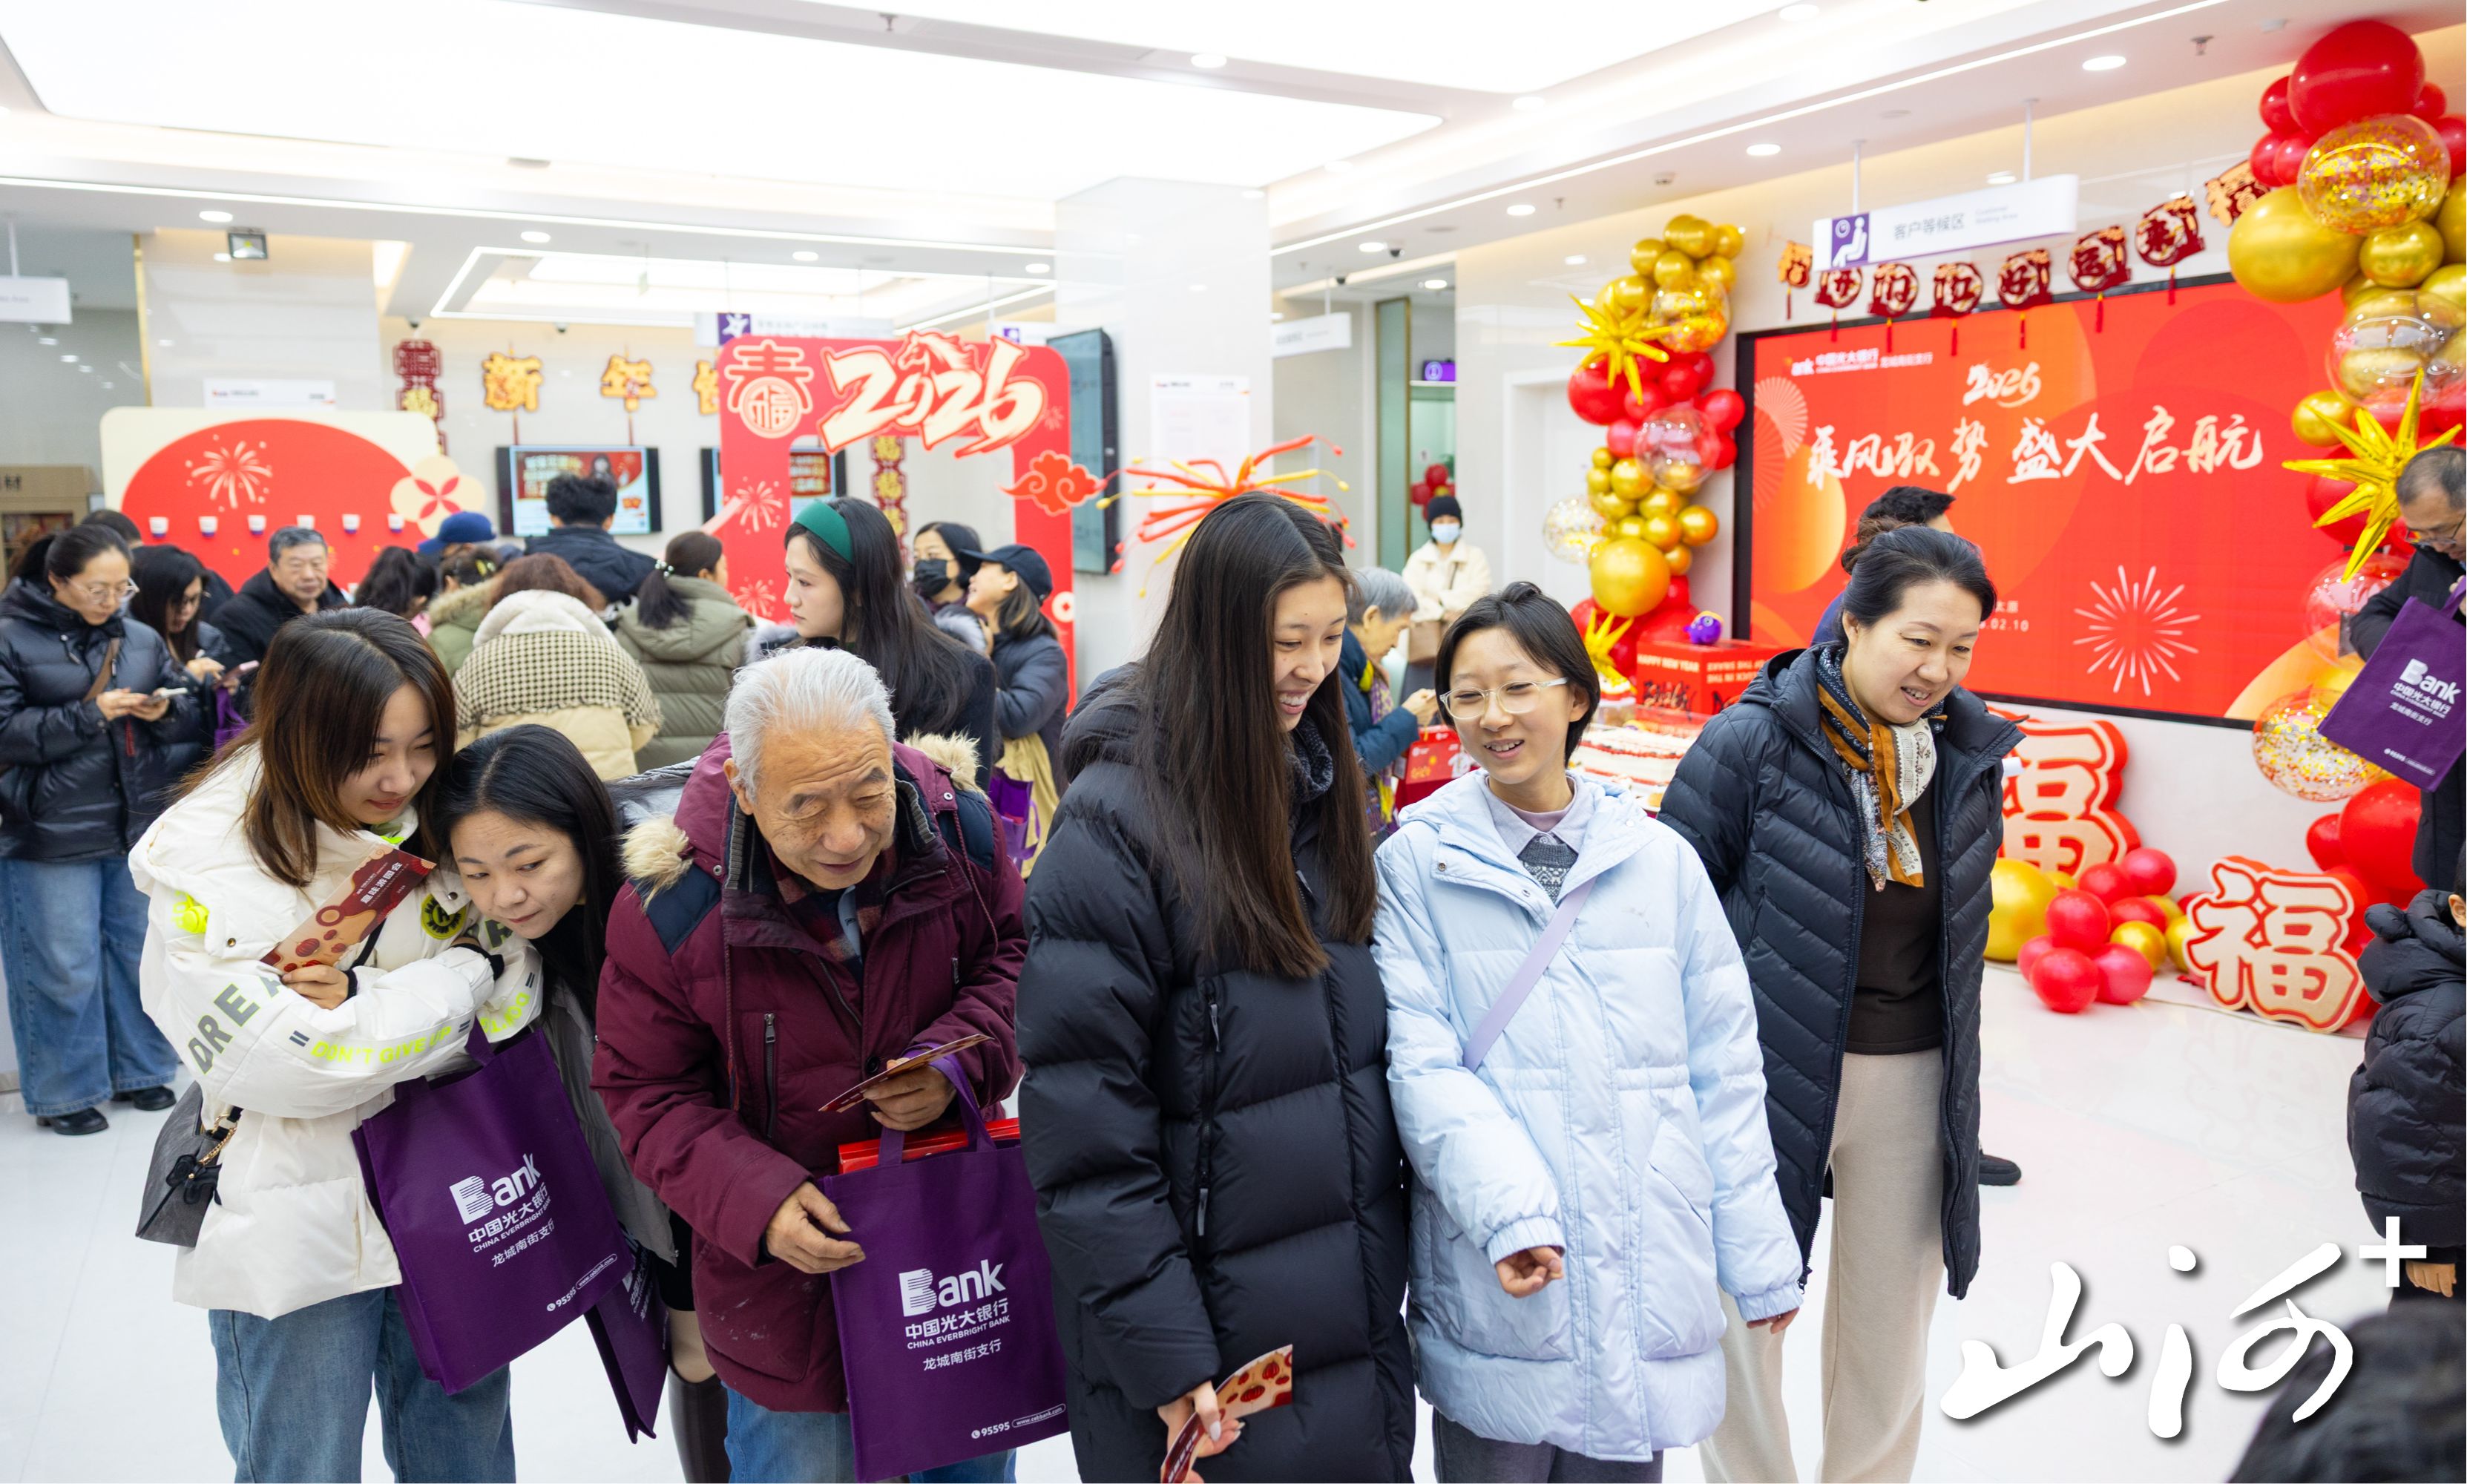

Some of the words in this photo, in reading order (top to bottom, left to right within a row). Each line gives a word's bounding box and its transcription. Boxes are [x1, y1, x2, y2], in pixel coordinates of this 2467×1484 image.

[1894, 212, 1965, 240] 客户等候区
[820, 334, 1048, 458] 2026
[1962, 361, 2042, 407] 2026
[1806, 416, 1988, 493] 乘风驭势
[2006, 405, 2264, 485] 盛大启航
[1637, 653, 1661, 668] HAPPY
[1662, 656, 1680, 670] NEW
[1680, 659, 1700, 674] YEAR
[2399, 658, 2461, 704] Bank
[2389, 701, 2433, 726] 龙城南街支行
[2393, 682, 2451, 715] 中国光大银行
[361, 862, 403, 904] 趣味游园会
[2185, 858, 2364, 1034] 福
[312, 1040, 373, 1064] DON'T
[380, 1037, 427, 1063] GIVE
[430, 1027, 451, 1047] UP
[449, 1153, 541, 1225] Bank
[468, 1182, 548, 1243] 中国光大银行
[473, 1237, 500, 1253] CHINA
[500, 1211, 544, 1240] EVERBRIGHT
[542, 1197, 551, 1212] BANK
[492, 1218, 555, 1267] 龙城南街支行
[556, 1287, 576, 1307] 95595
[899, 1259, 1006, 1317] Bank
[904, 1298, 1009, 1339] 中国光大银行
[907, 1339, 935, 1350] CHINA
[936, 1323, 988, 1345] EVERBRIGHT
[988, 1315, 1011, 1329] BANK
[922, 1339, 1002, 1371] 龙城南街支行
[980, 1422, 1010, 1437] 95595
[1016, 1407, 1062, 1426] www.cebbank.com
